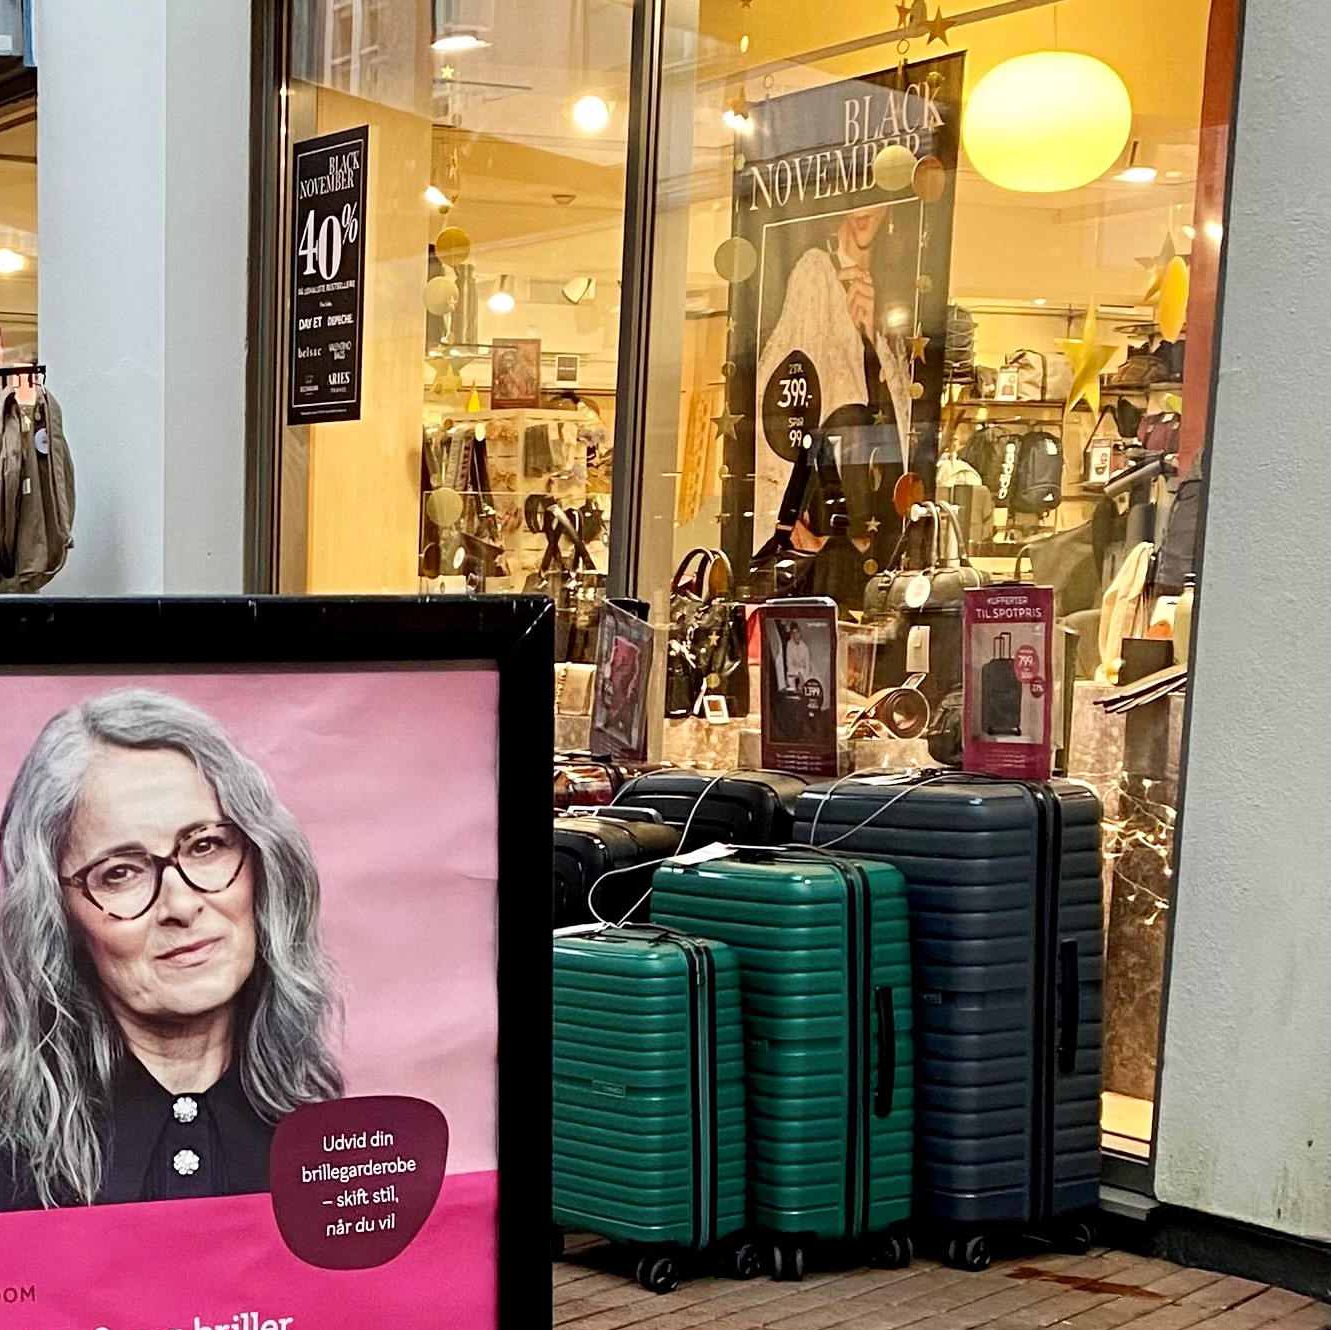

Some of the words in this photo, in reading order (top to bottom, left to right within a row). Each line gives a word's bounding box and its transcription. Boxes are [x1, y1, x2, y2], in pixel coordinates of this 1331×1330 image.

[843, 81, 945, 147] BLACK
[329, 150, 360, 175] BLACK
[299, 169, 354, 200] NOVEMBER
[298, 202, 358, 280] 40%
[298, 318, 312, 331] DAY
[313, 316, 323, 329] ET
[998, 443, 1016, 500] adidas
[976, 608, 992, 618] TIL
[992, 607, 1042, 619] SPOTPRIS
[323, 1132, 366, 1151] Udvid
[370, 1131, 393, 1147] din
[302, 1157, 416, 1183] brillegarderobe
[336, 1188, 369, 1208] skift
[373, 1185, 399, 1203] stil,
[326, 1219, 352, 1236] når
[355, 1217, 374, 1233] du
[379, 1213, 395, 1230] vil
